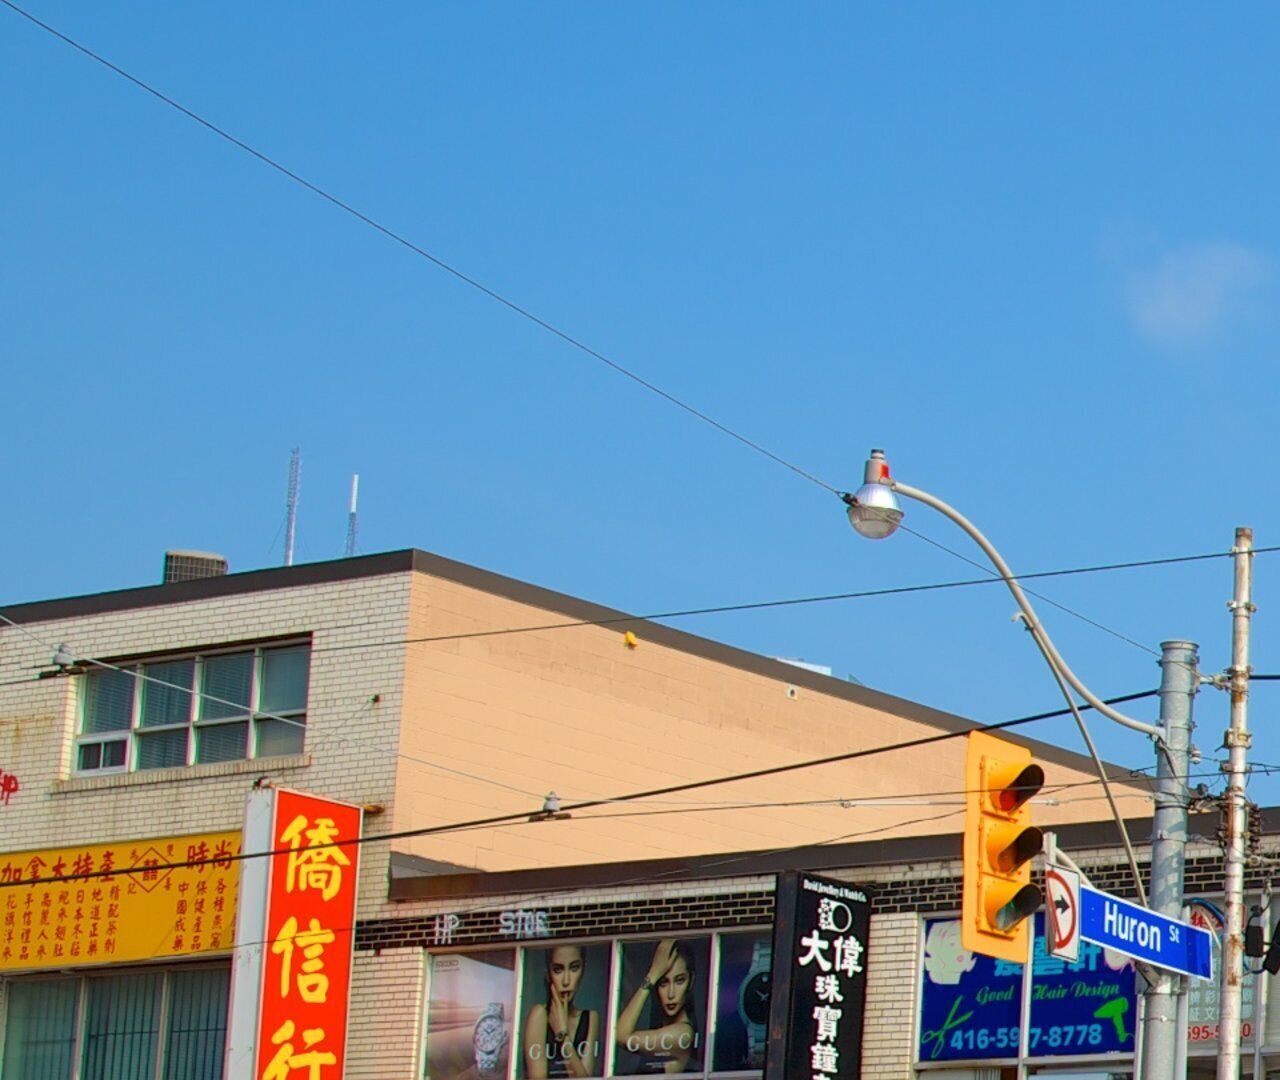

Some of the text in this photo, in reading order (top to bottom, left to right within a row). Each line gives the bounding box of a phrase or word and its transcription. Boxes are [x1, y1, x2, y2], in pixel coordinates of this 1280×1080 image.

[187, 840, 241, 873] 時尚
[1104, 901, 1160, 952] Huron
[1169, 927, 1179, 943] St
[798, 929, 864, 978] 大偉
[976, 981, 1120, 1005] Good Hair Design
[529, 1040, 598, 1061] GUCCI
[627, 1032, 698, 1052] GUCCI
